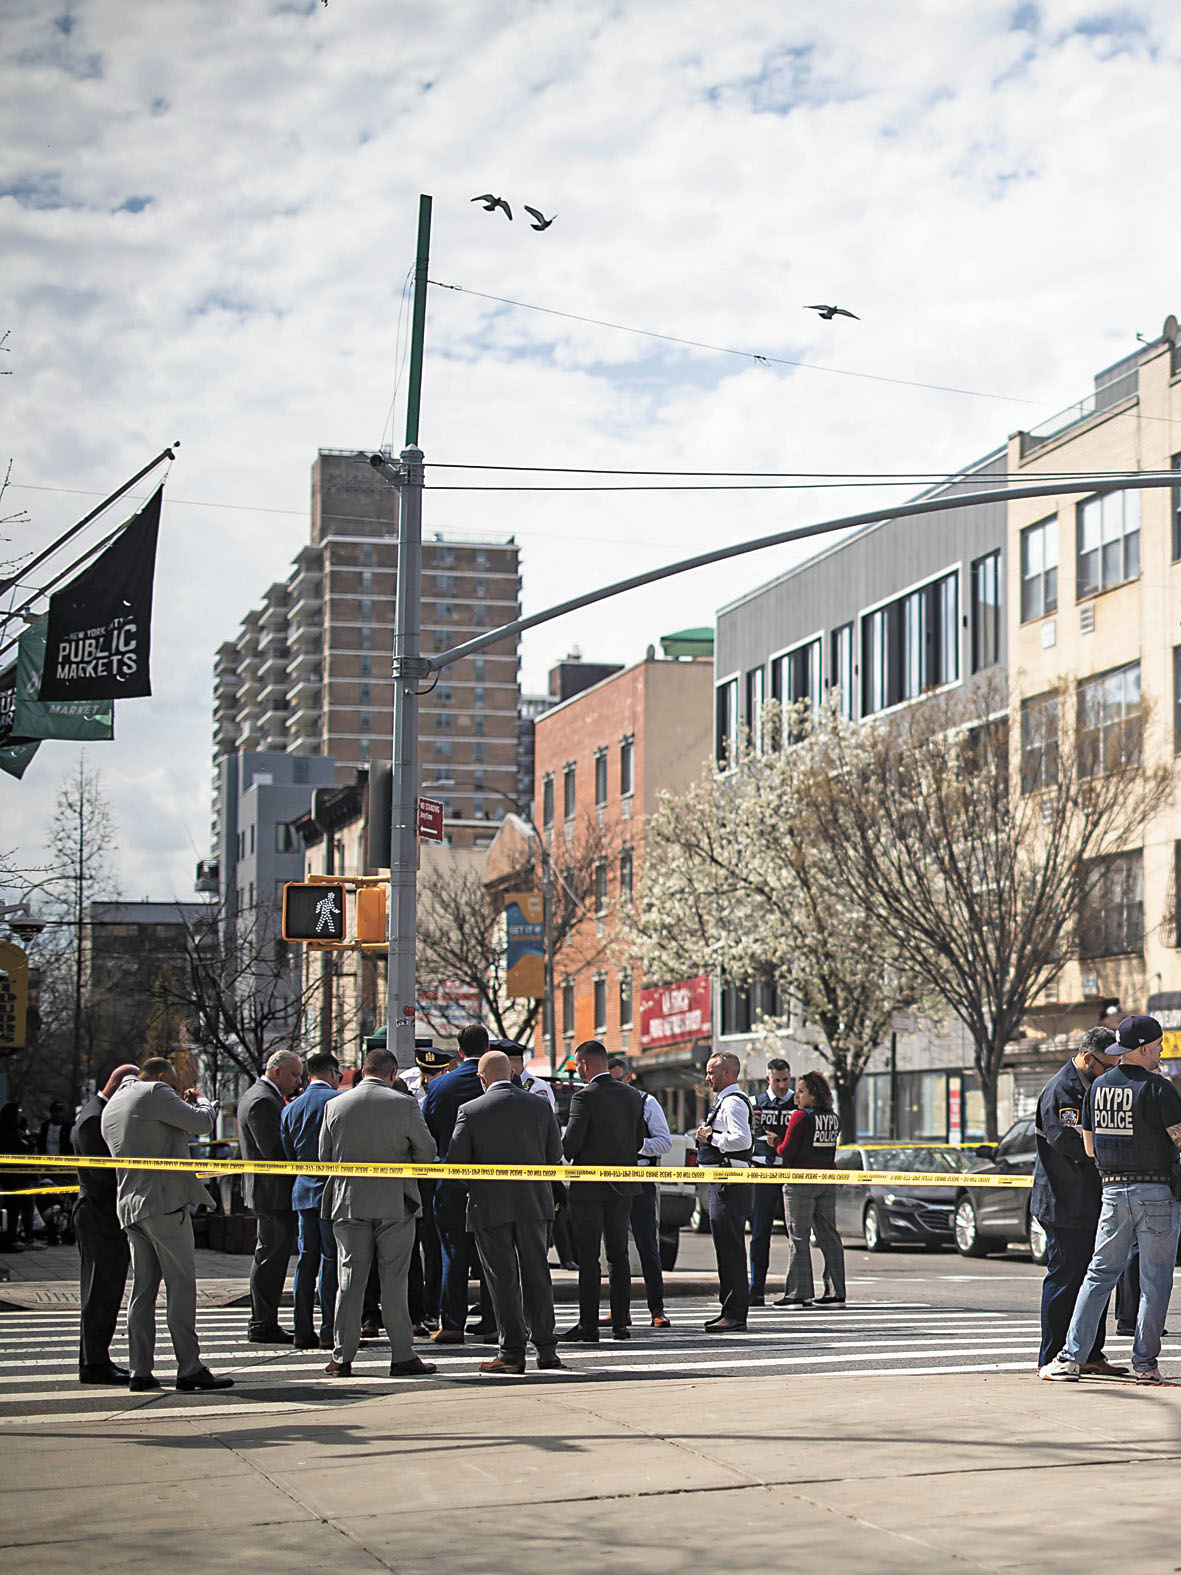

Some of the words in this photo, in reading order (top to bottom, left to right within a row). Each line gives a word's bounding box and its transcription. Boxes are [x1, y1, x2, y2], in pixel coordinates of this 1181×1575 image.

[87, 627, 106, 637] YORK
[58, 623, 137, 662] PUBLIC
[57, 653, 137, 679] MARKETS
[49, 704, 100, 715] MARKET
[1094, 1087, 1133, 1111] NYPD
[760, 1113, 791, 1126] POLIC
[814, 1114, 839, 1131] NYPD
[1094, 1111, 1133, 1128] POLICE
[813, 1130, 839, 1142] POLICE
